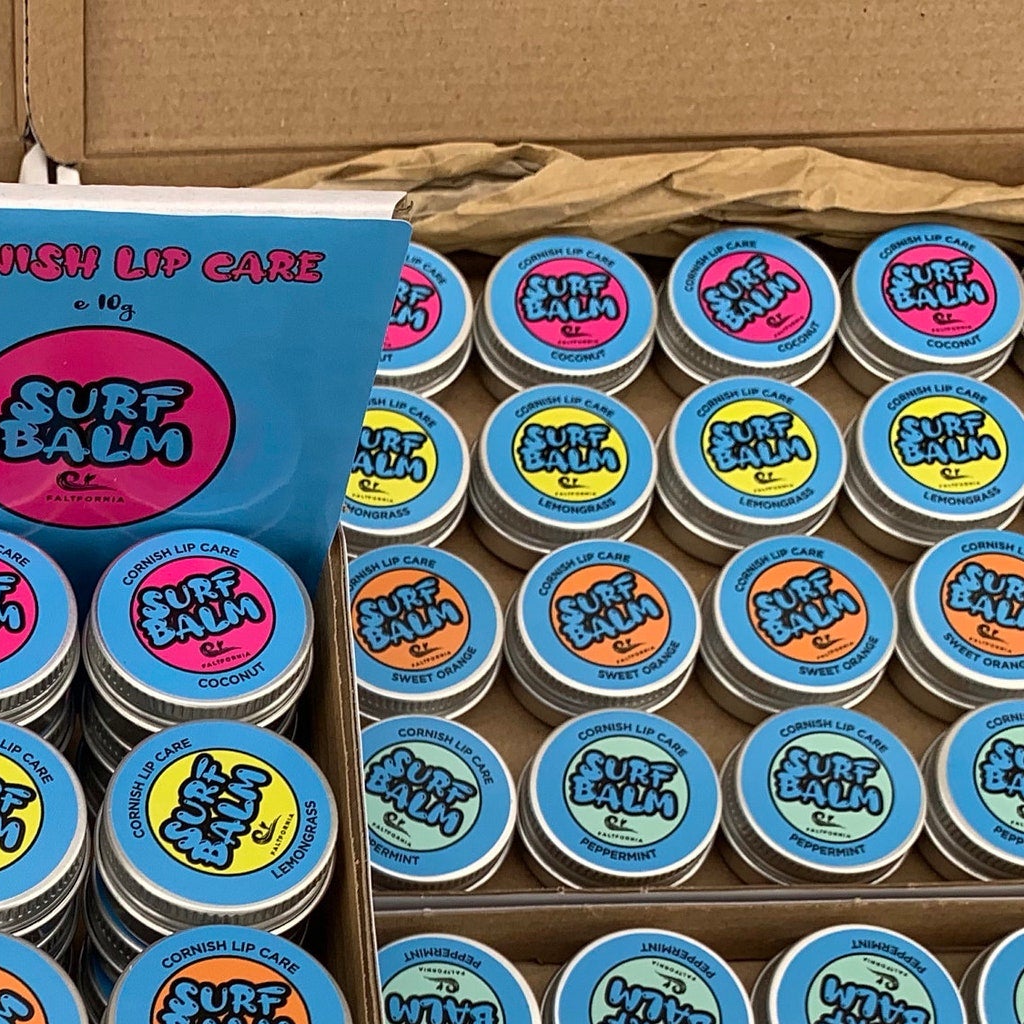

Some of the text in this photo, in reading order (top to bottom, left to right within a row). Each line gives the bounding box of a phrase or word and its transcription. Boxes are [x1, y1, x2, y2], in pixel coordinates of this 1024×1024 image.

[114, 242, 188, 282] LIP
[202, 249, 325, 284] CARE
[517, 247, 614, 269] CORNISH LIP CARE
[524, 272, 609, 300] SURF
[98, 294, 136, 321] 10g
[520, 296, 620, 320] BALM
[550, 348, 608, 361] COCONUT
[7, 375, 193, 425] SURF
[708, 411, 793, 450] SURF
[708, 436, 811, 472] BALM
[45, 493, 125, 504] FALTFORNIA
[739, 486, 815, 508] LEMONGRASS
[121, 542, 238, 585] CORNISH LIP CARE
[138, 566, 240, 621] SURF
[752, 566, 832, 622] SURF
[139, 593, 266, 648] BALM
[759, 589, 860, 646] BALM
[198, 650, 250, 672] FALTFORNIA
[198, 661, 267, 687] COCONUT
[799, 635, 878, 675] SWEET ORANGE
[0, 737, 23, 754] LIP
[21, 750, 53, 784] CARE
[578, 749, 676, 788] SURF
[127, 737, 192, 839] CORNISH LIP CARE
[158, 753, 227, 852] SURF
[570, 773, 677, 819] BALM
[188, 764, 270, 868] BALM
[270, 811, 295, 856] FALTFORNIA
[272, 799, 317, 878] LEMONGRASS
[579, 837, 658, 860] PEPPERMINT
[159, 939, 300, 974] CORNISH LIP CARE
[640, 942, 717, 978] PEPPERMINT
[165, 978, 290, 1017] SURF
